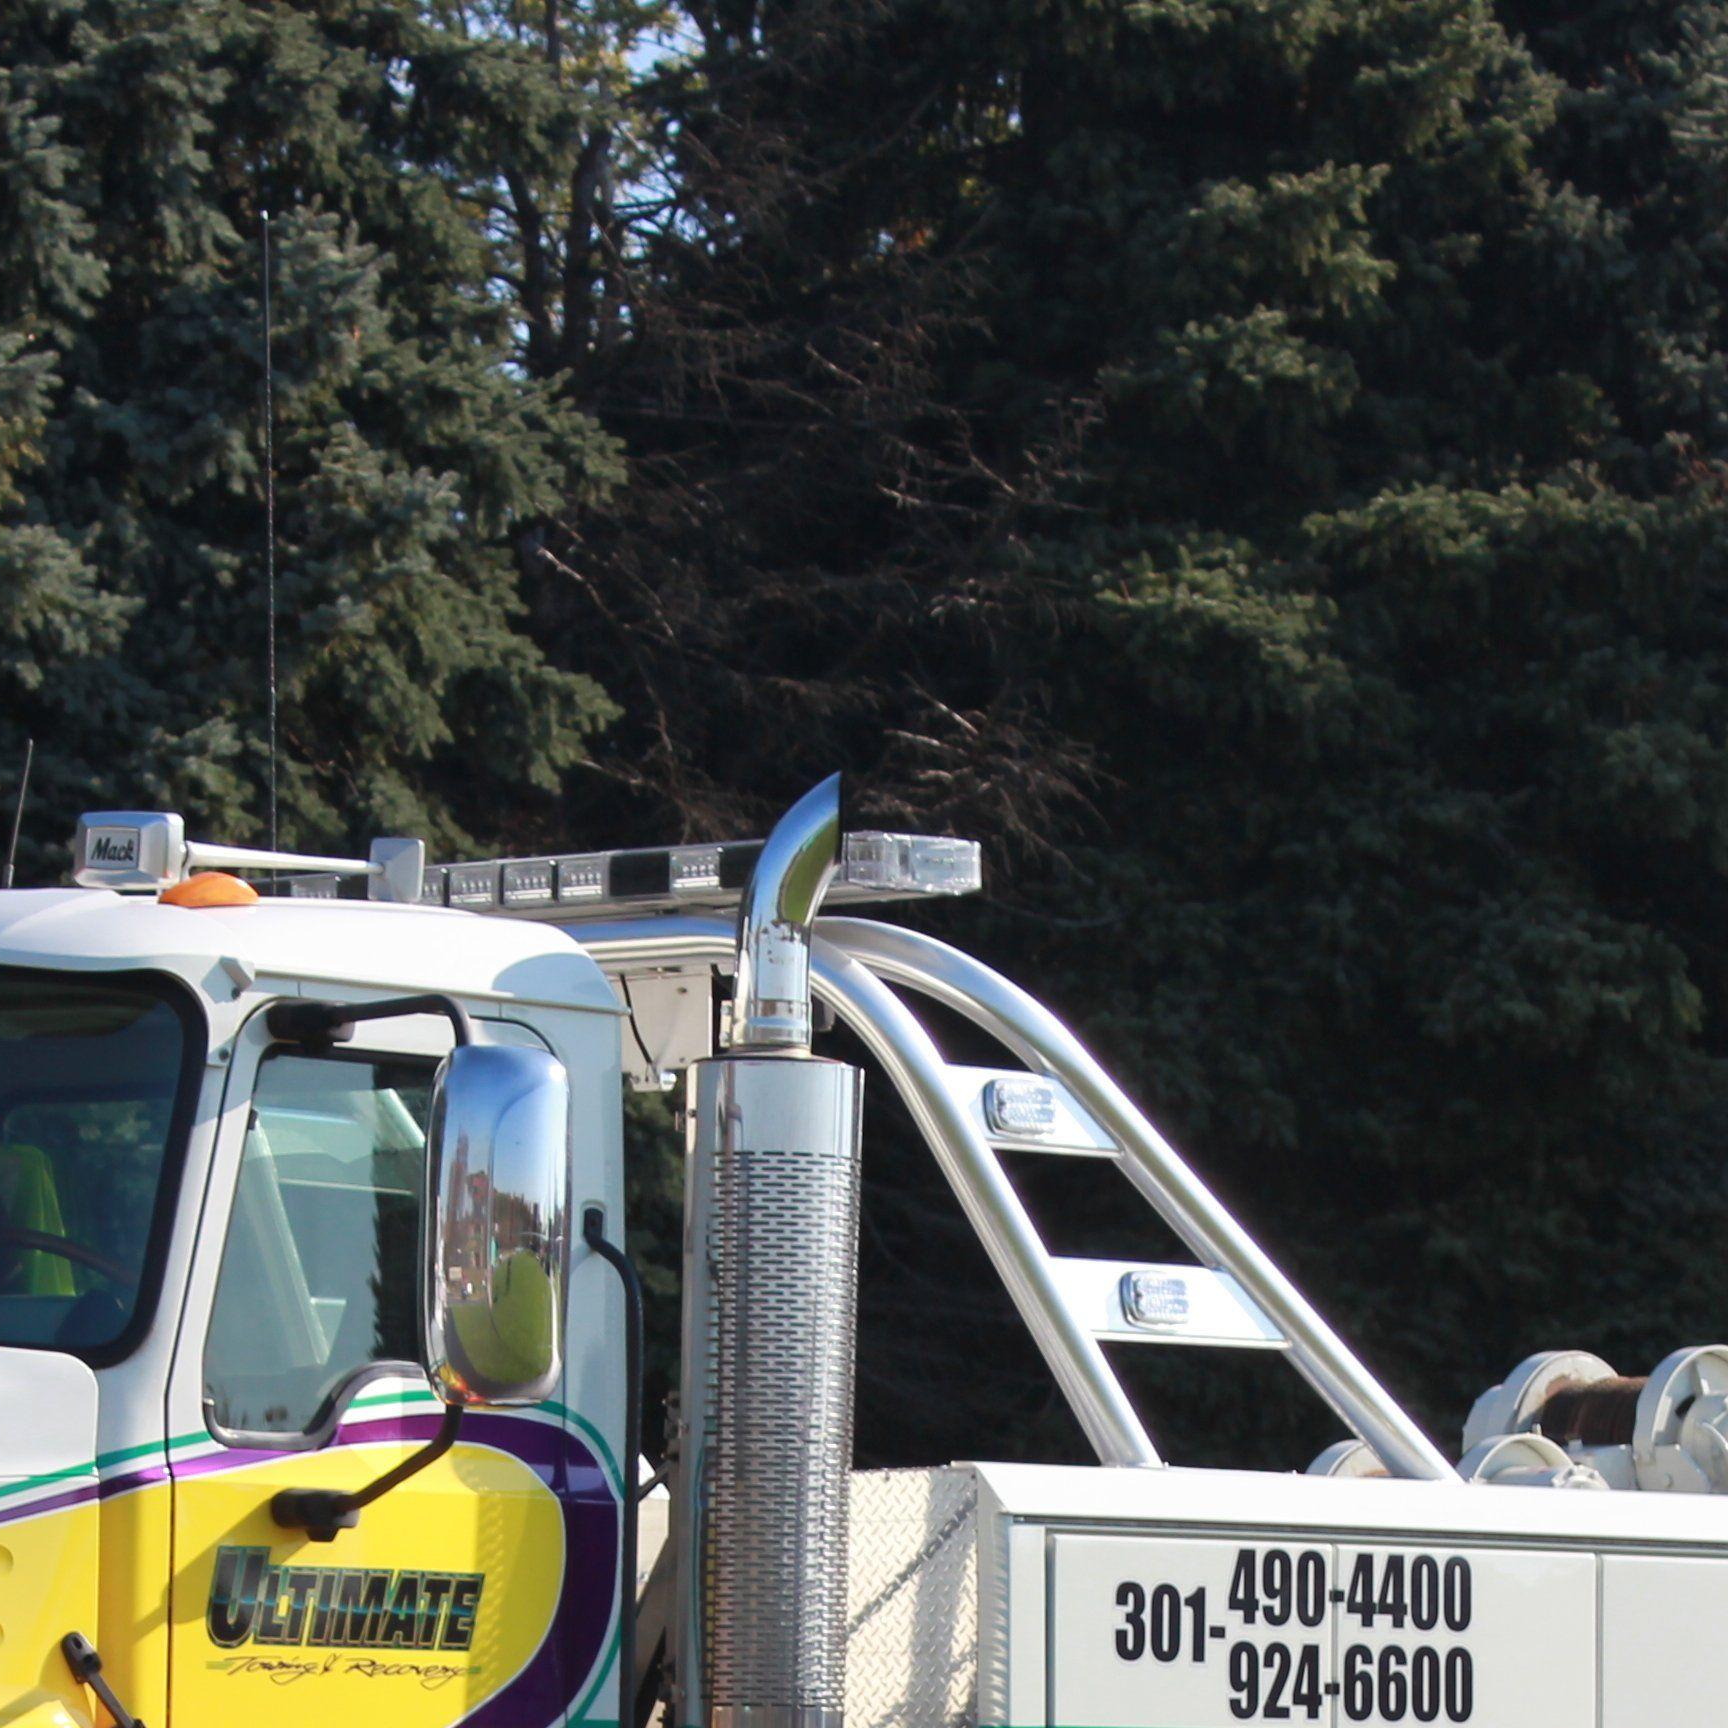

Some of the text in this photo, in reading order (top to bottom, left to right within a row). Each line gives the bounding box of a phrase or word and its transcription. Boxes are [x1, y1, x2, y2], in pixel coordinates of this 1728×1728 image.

[91, 837, 135, 862] Mack
[206, 1545, 485, 1651] ULTIMATE
[1115, 1581, 1226, 1663] 301-
[1228, 1548, 1472, 1632] 490-4400
[223, 1655, 319, 1686] Towing
[344, 1657, 468, 1691] Recovery
[1228, 1641, 1473, 1723] 924-6600
